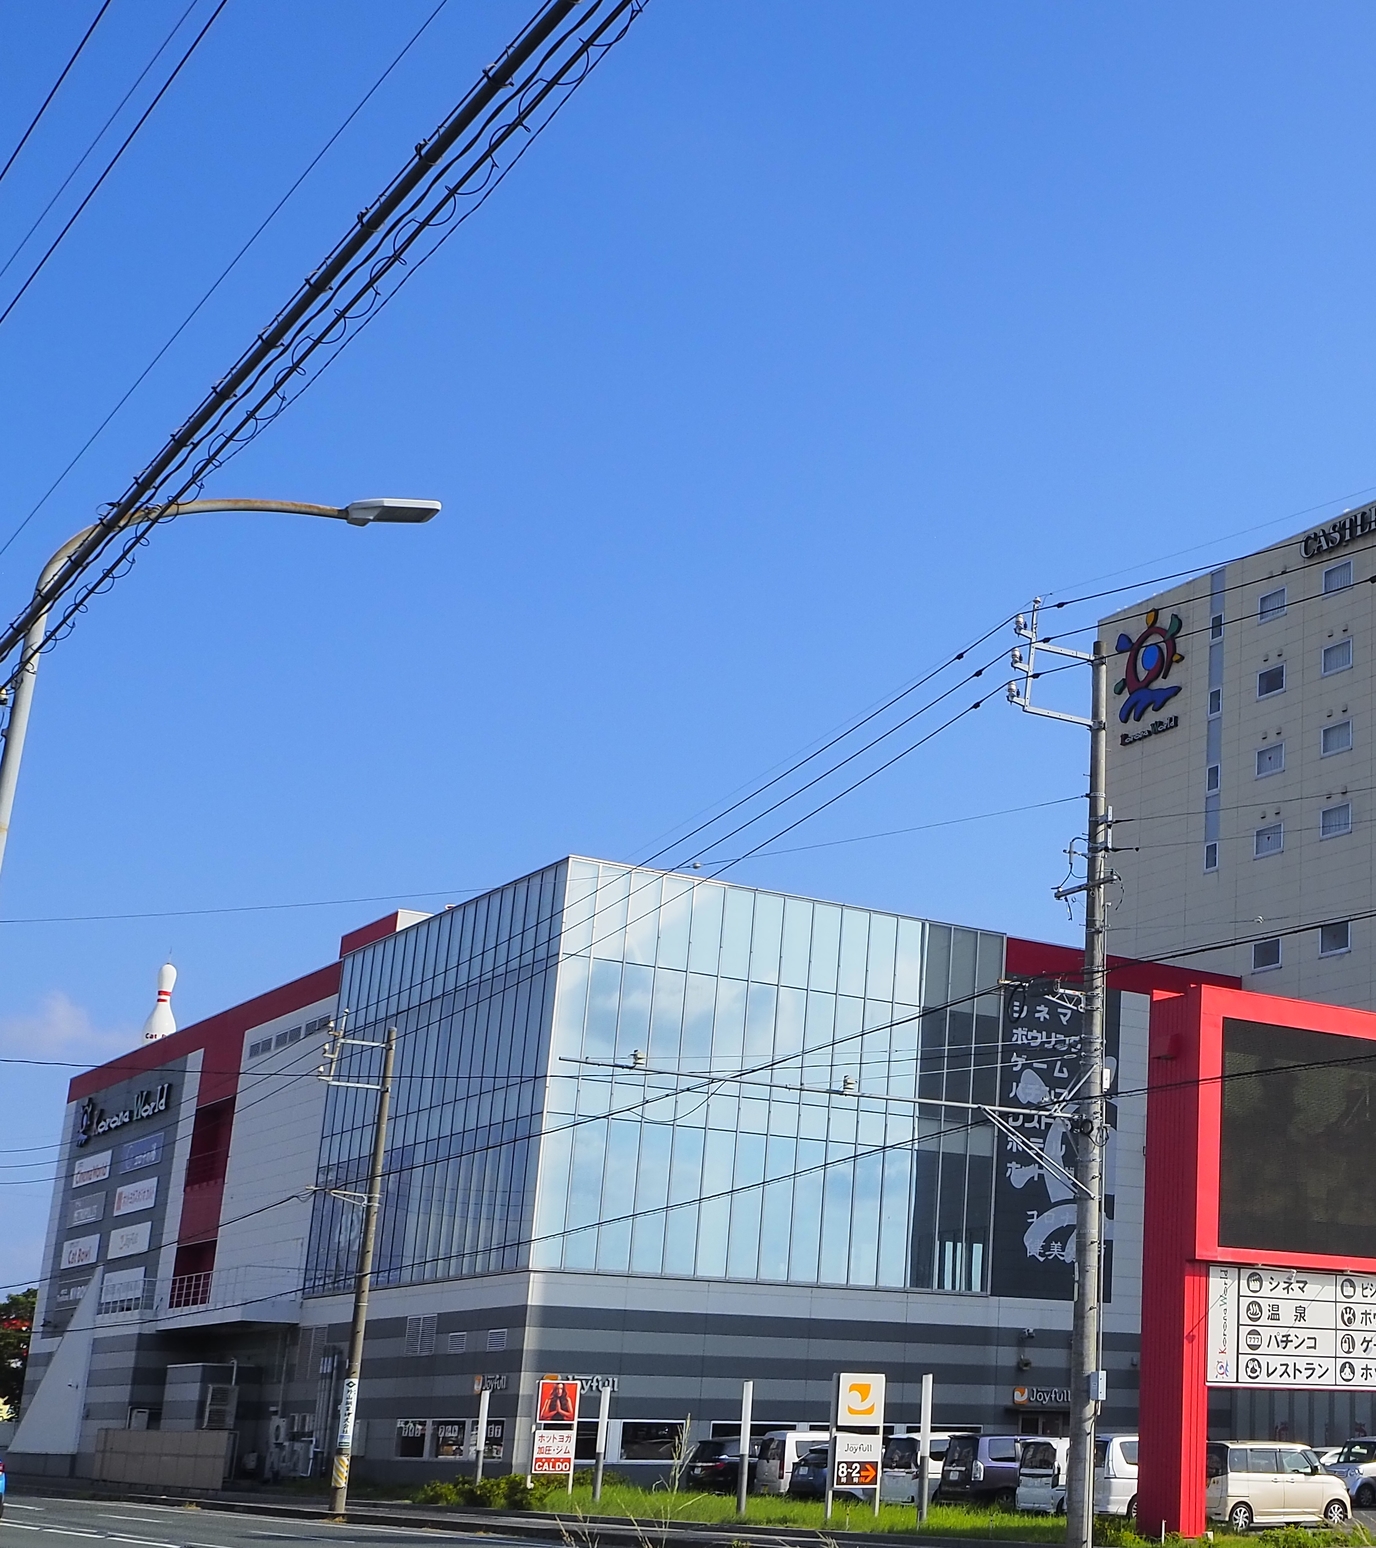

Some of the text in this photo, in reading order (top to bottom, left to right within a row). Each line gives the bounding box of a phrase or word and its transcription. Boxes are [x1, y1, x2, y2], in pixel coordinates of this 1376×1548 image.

[1012, 1001, 1072, 1025] シネマ
[1011, 1052, 1069, 1078] ゲーム
[91, 1083, 169, 1136] Korona World
[1268, 1276, 1309, 1295] シネマ
[1267, 1304, 1307, 1323] 温泉
[1267, 1332, 1318, 1351] パチンコ
[1267, 1361, 1330, 1380] レストラン
[1030, 1387, 1071, 1405] Joyfull
[538, 1434, 573, 1444] ホットヨガ
[844, 1443, 873, 1454] Joyfull
[535, 1461, 570, 1471] CALDO
